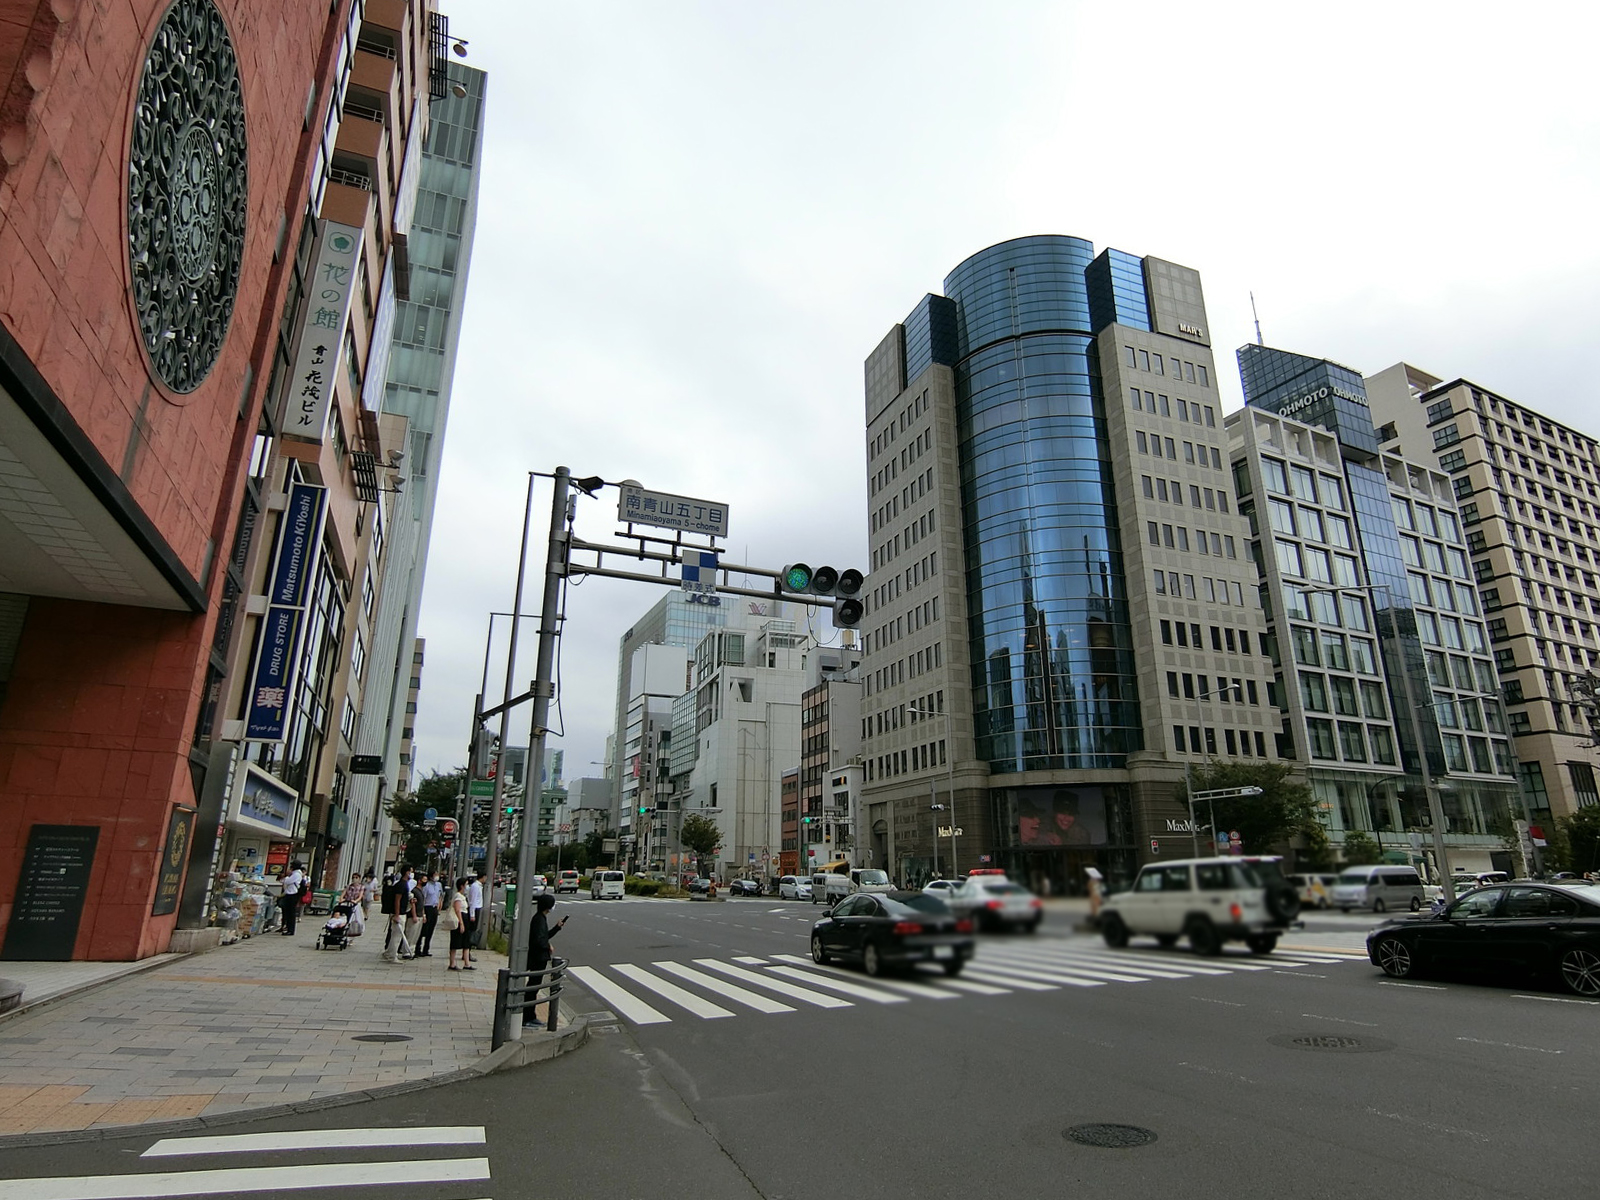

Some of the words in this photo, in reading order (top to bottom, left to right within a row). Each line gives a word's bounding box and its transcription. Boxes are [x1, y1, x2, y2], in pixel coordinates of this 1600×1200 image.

[312, 262, 351, 331] 花の館
[1179, 323, 1203, 337] MAR'S
[1278, 387, 1328, 418] OHMOTO
[1333, 386, 1369, 406] OHMOTO
[625, 494, 722, 523] 南青山五丁目
[626, 509, 682, 526] Minamiaoyama
[685, 593, 721, 606] JCB
[275, 612, 290, 646] STORE
[269, 647, 283, 676] DRUG
[256, 686, 286, 708] 薬
[1166, 819, 1200, 832] MaxMra
